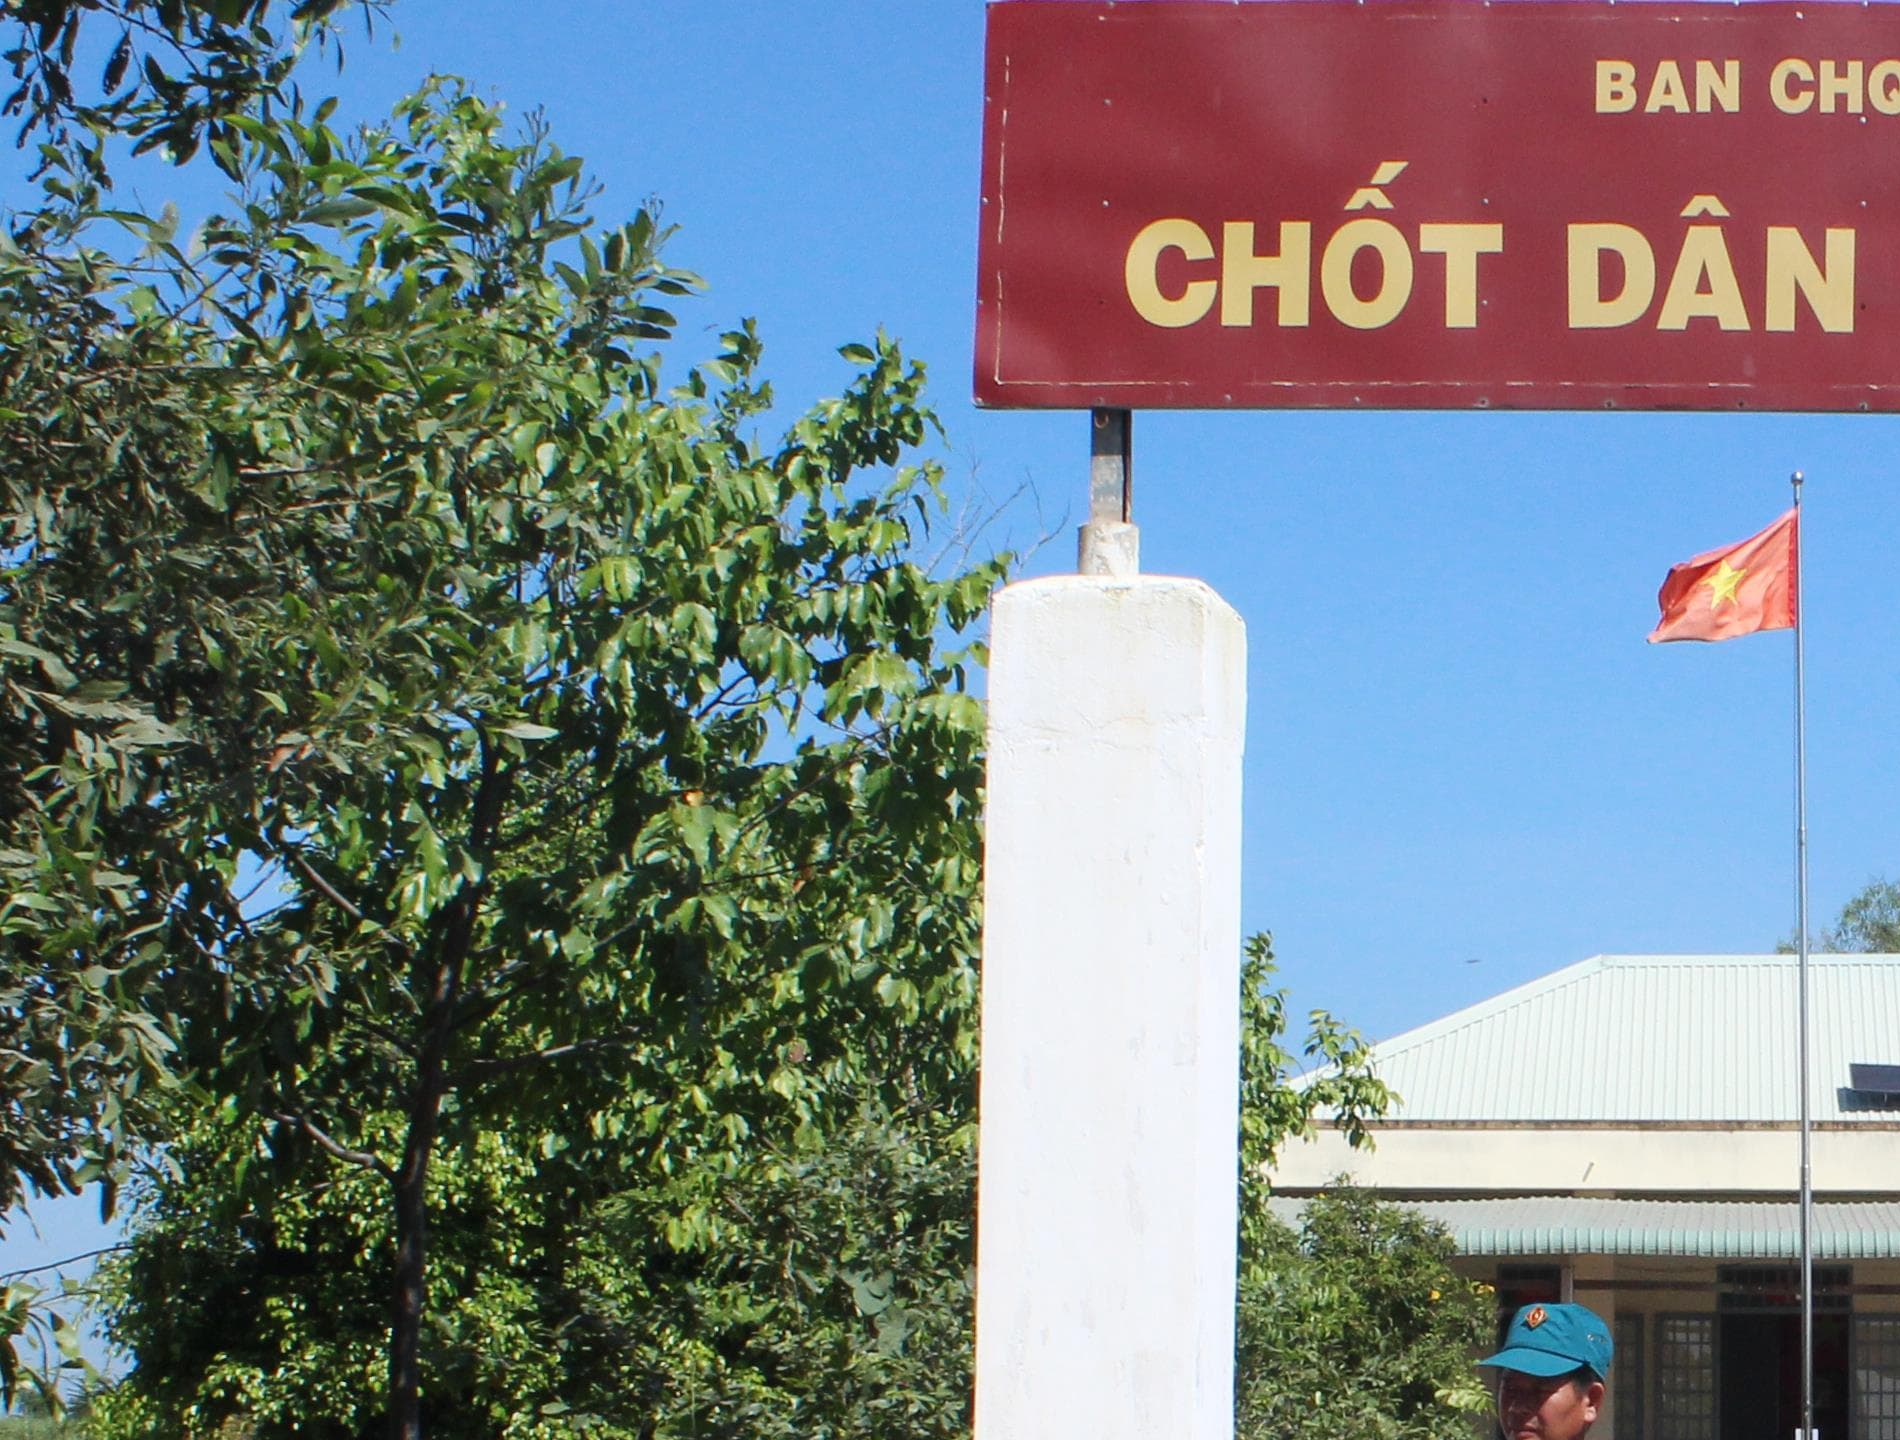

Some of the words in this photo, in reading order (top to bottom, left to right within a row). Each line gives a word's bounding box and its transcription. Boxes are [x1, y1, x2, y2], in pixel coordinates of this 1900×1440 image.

[1596, 60, 1740, 113] BAN
[1125, 161, 1503, 329] CHỐT
[1567, 195, 1856, 333] DÂN
